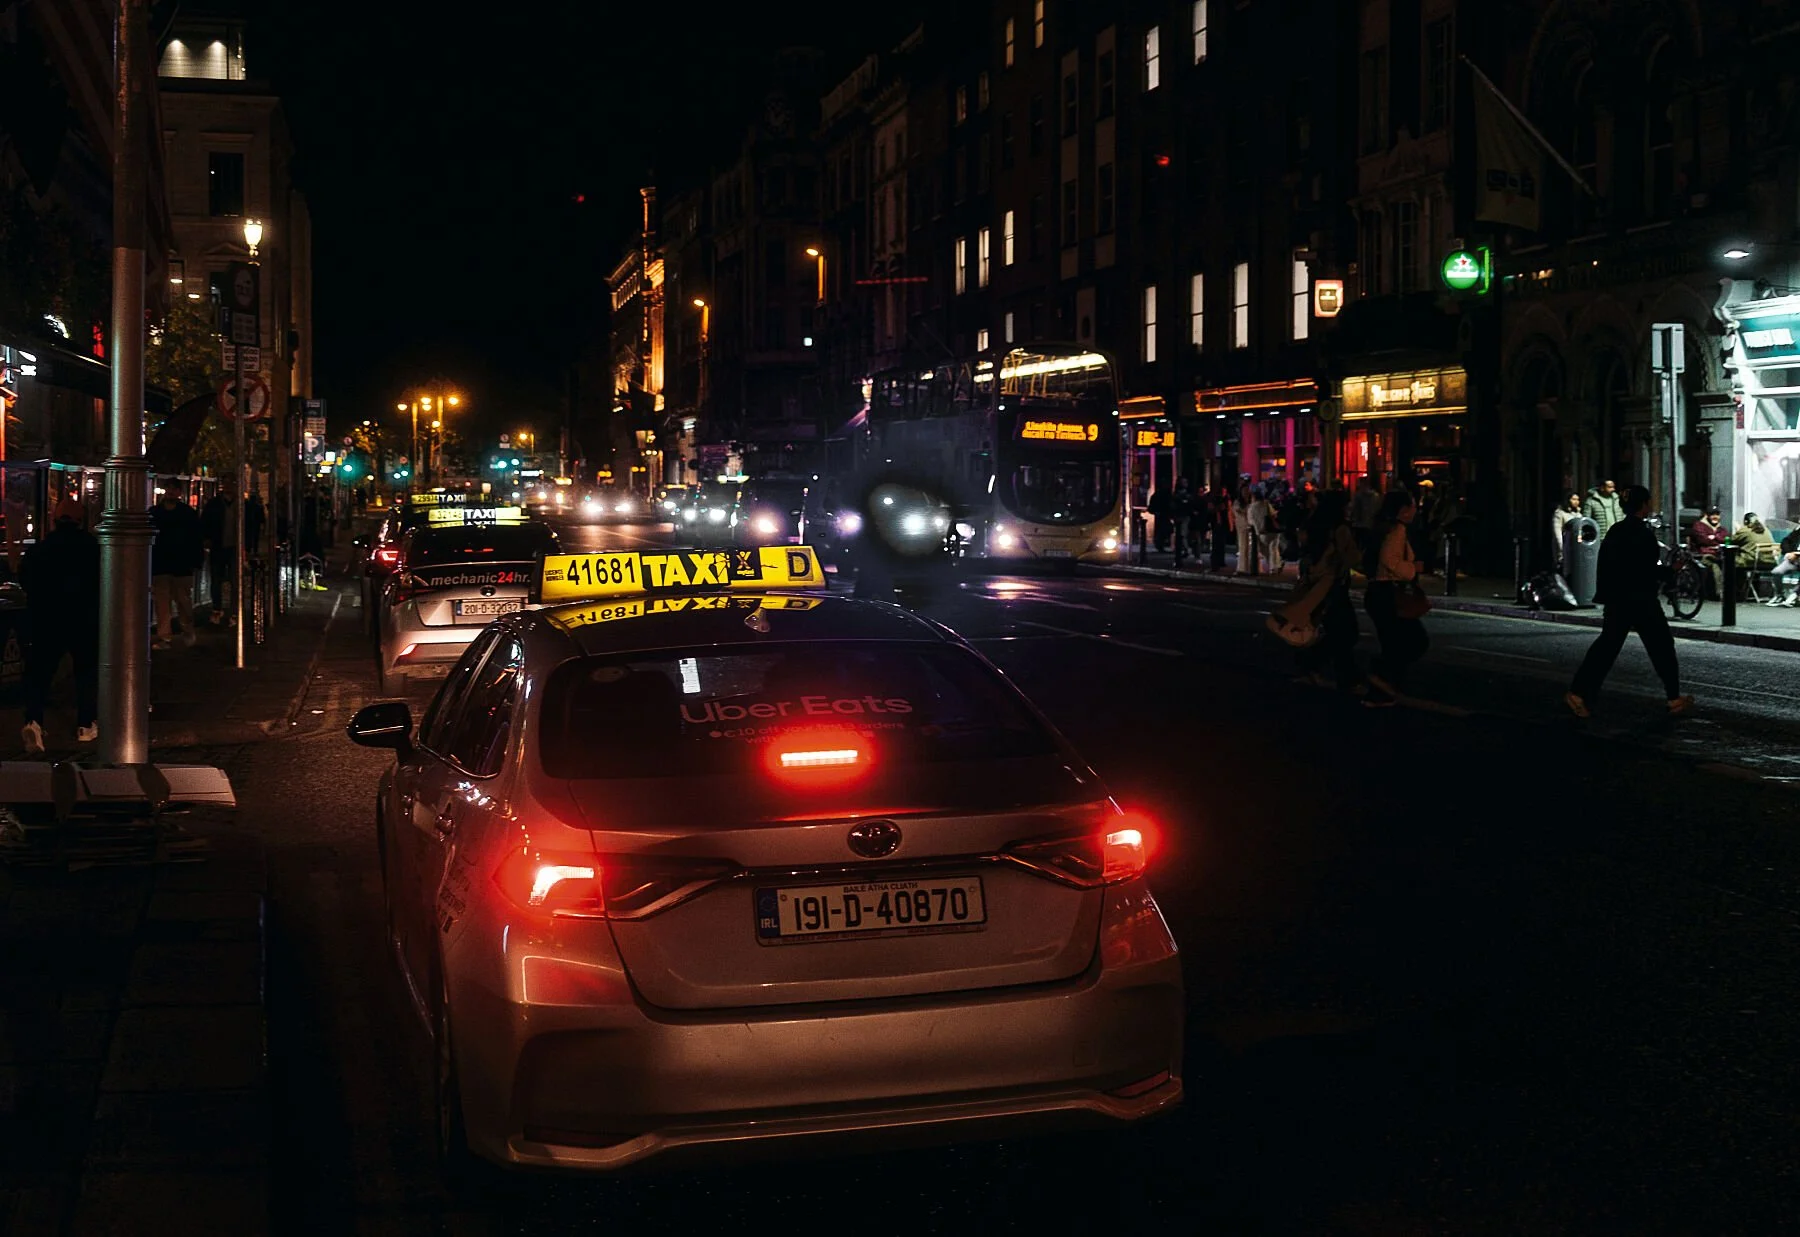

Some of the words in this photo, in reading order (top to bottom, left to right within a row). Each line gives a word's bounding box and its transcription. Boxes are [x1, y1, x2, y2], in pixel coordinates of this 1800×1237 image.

[1088, 424, 1098, 441] 9
[440, 494, 465, 503] TAXI
[464, 508, 495, 519] TAXI
[567, 556, 637, 586] 41681
[788, 552, 810, 577] D
[679, 700, 792, 724] Uber
[800, 695, 913, 716] Eats
[858, 721, 905, 731] orders
[794, 887, 969, 931] 191-D-40870
[760, 917, 779, 929] IRL
